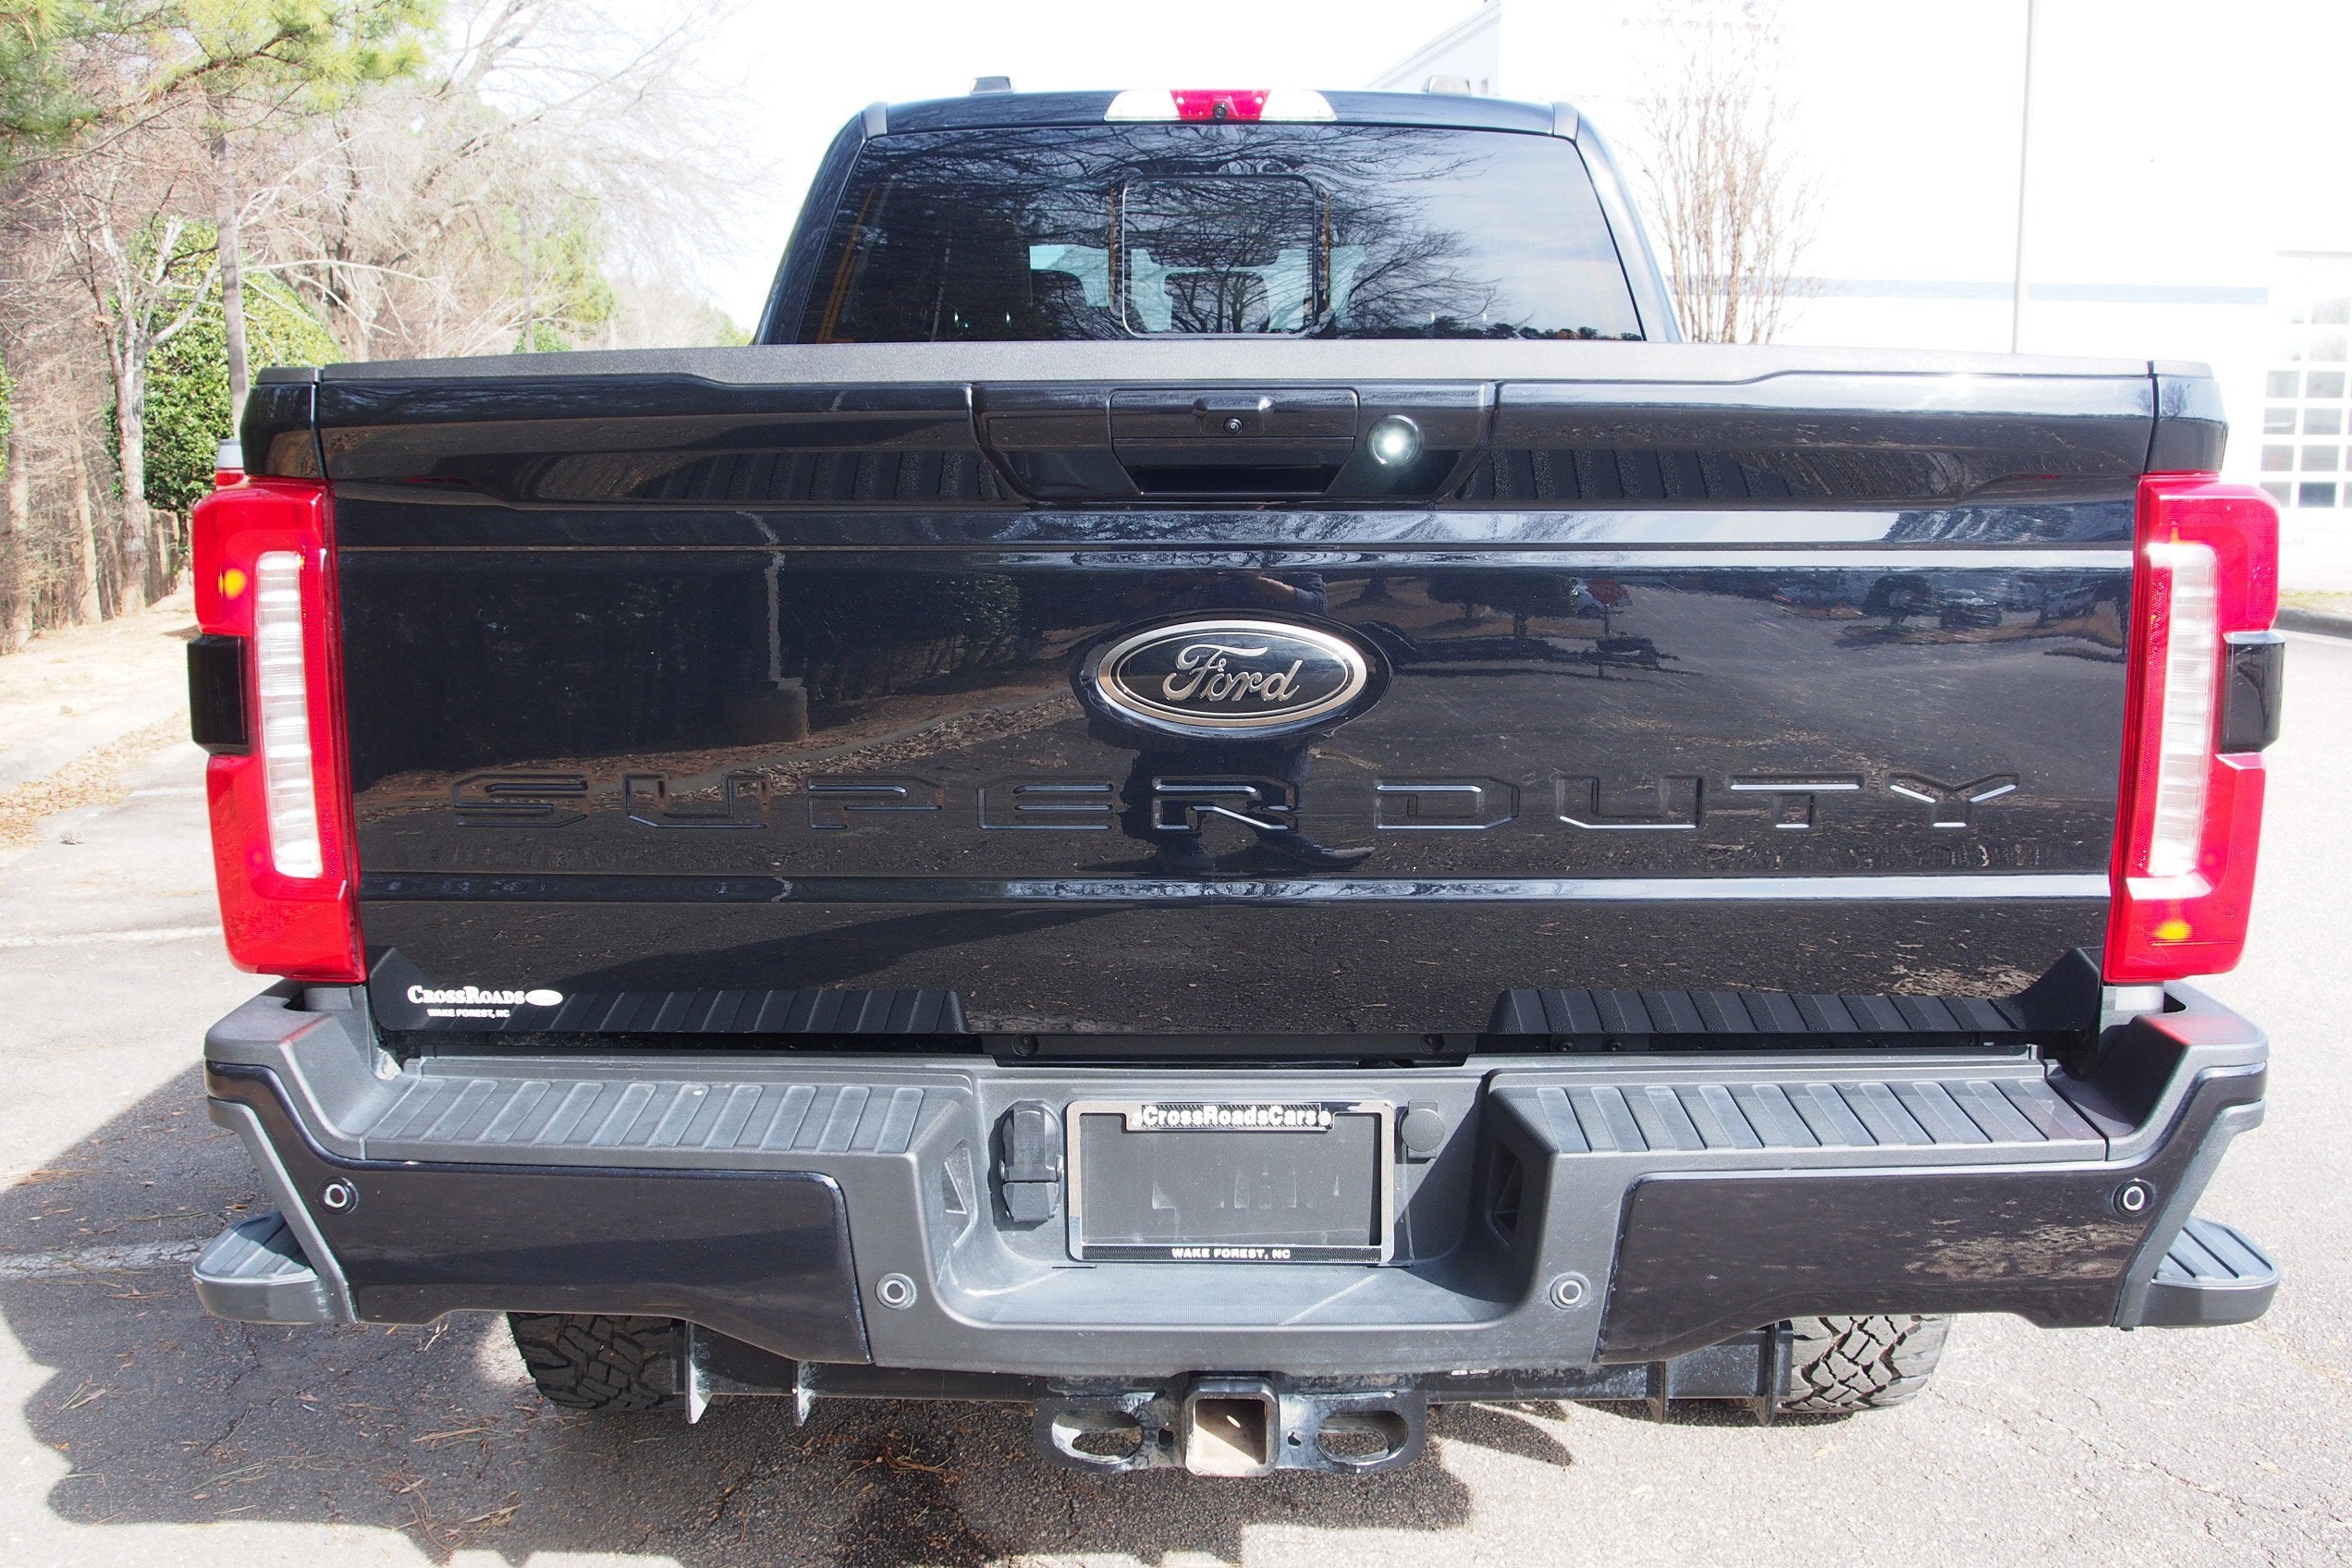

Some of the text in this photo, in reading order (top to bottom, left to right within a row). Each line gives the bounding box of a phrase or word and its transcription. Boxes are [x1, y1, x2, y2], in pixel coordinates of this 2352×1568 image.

[1162, 643, 1304, 702] Ford
[451, 771, 2021, 830] SUPER DUTY
[427, 1008, 456, 1018] WAKE
[1143, 1105, 1317, 1126] CrossRoadsCars
[1171, 1248, 1291, 1260] WAKE FOREST, NC
